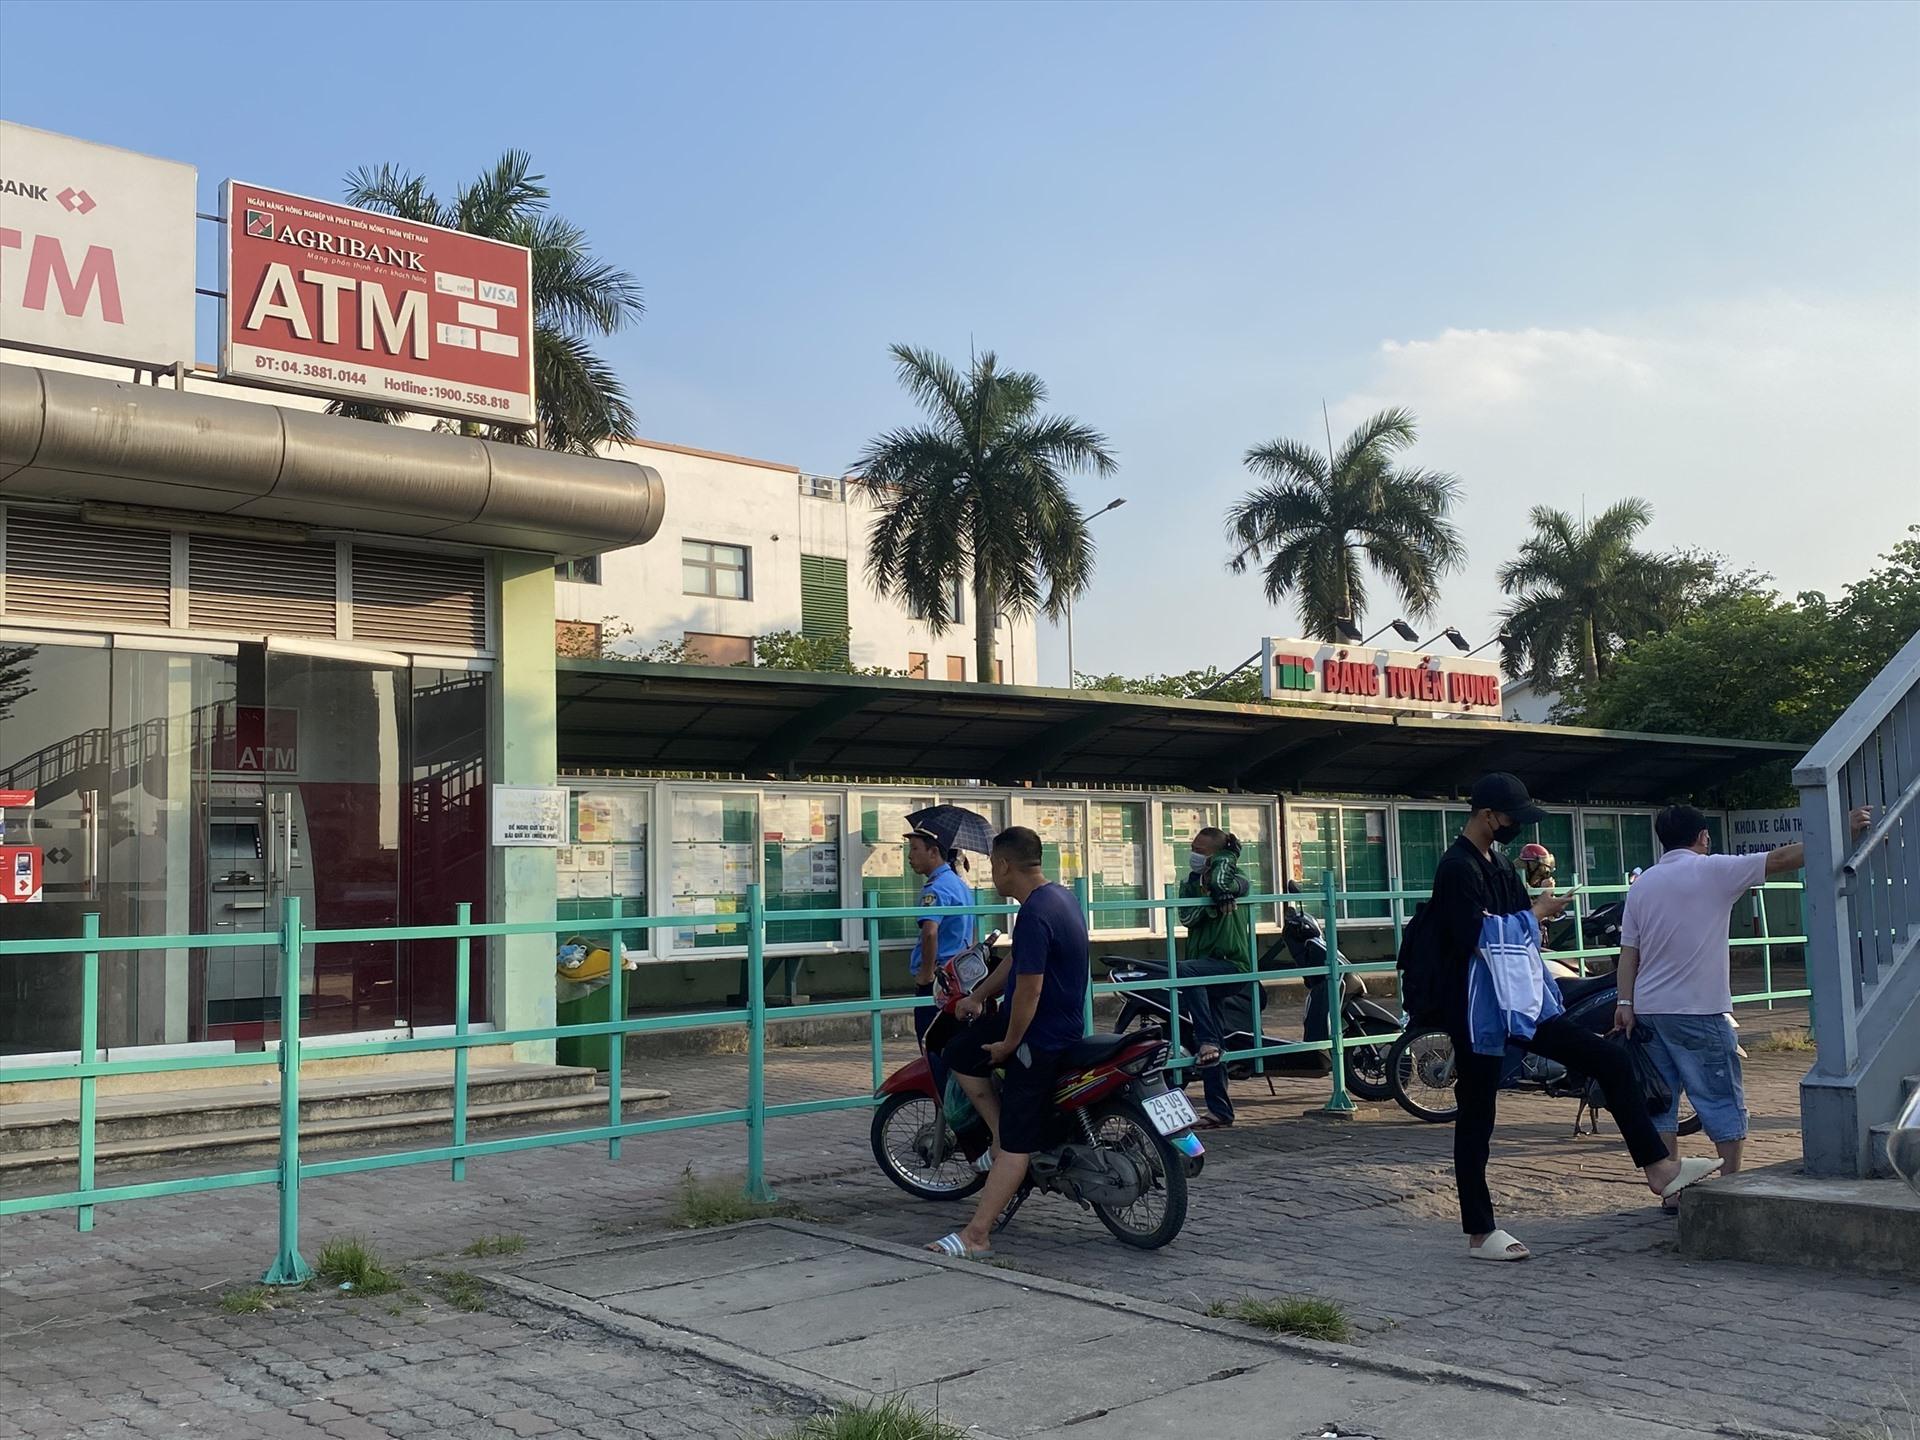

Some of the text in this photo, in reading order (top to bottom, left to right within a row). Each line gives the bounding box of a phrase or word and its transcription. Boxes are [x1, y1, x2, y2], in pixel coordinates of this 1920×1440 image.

[277, 224, 428, 273] AGRIBANK
[307, 252, 329, 263] Mang
[482, 285, 516, 304] VISA
[246, 262, 430, 361] ATM
[1322, 649, 1380, 697] BẢNG
[1385, 655, 1445, 702] TUYỂN
[1448, 671, 1500, 712] DỤNG
[238, 746, 295, 769] ATM
[1734, 817, 1757, 834] KHÓA
[1758, 819, 1769, 833] XE
[1160, 1108, 1193, 1130] 1215
